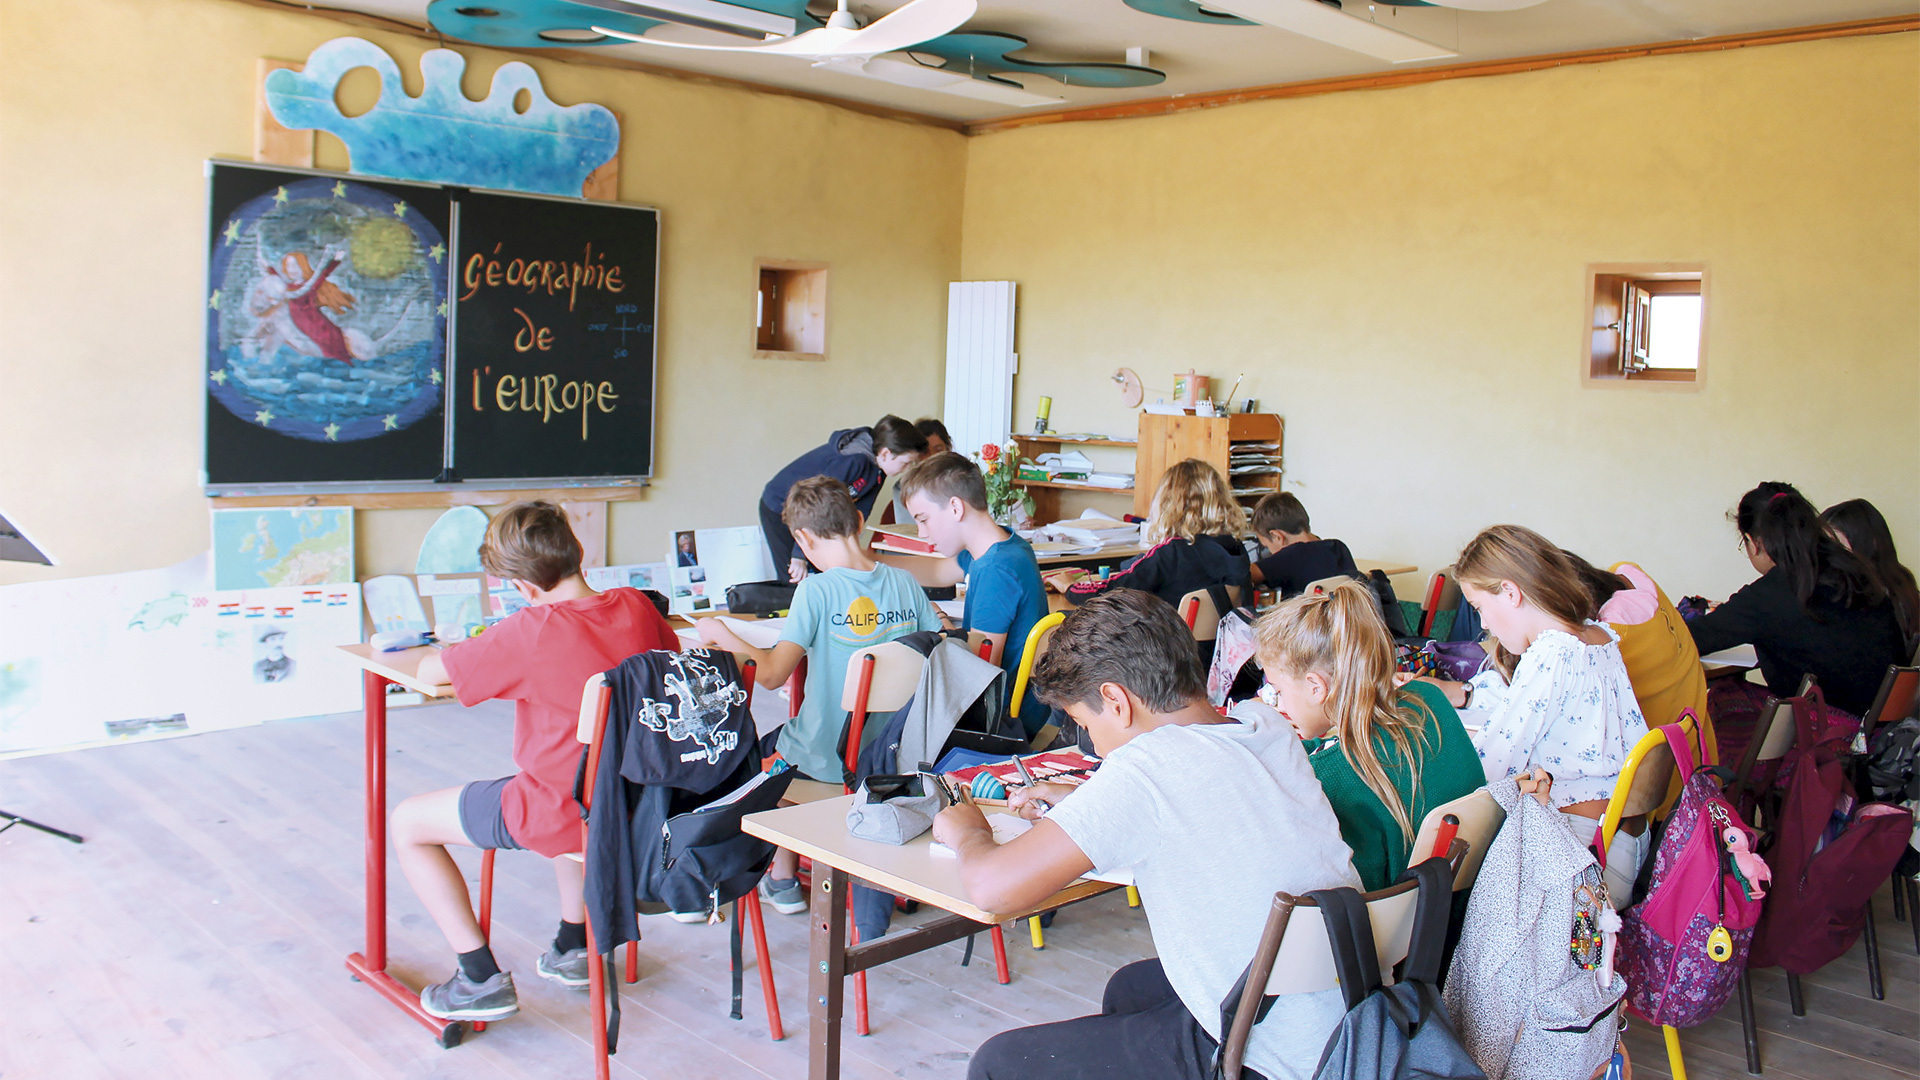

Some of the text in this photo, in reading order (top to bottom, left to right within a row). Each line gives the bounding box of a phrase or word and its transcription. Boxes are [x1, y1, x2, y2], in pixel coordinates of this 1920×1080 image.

[615, 304, 638, 315] NORD
[513, 307, 556, 353] de
[831, 608, 917, 627] CALIFORNIA
